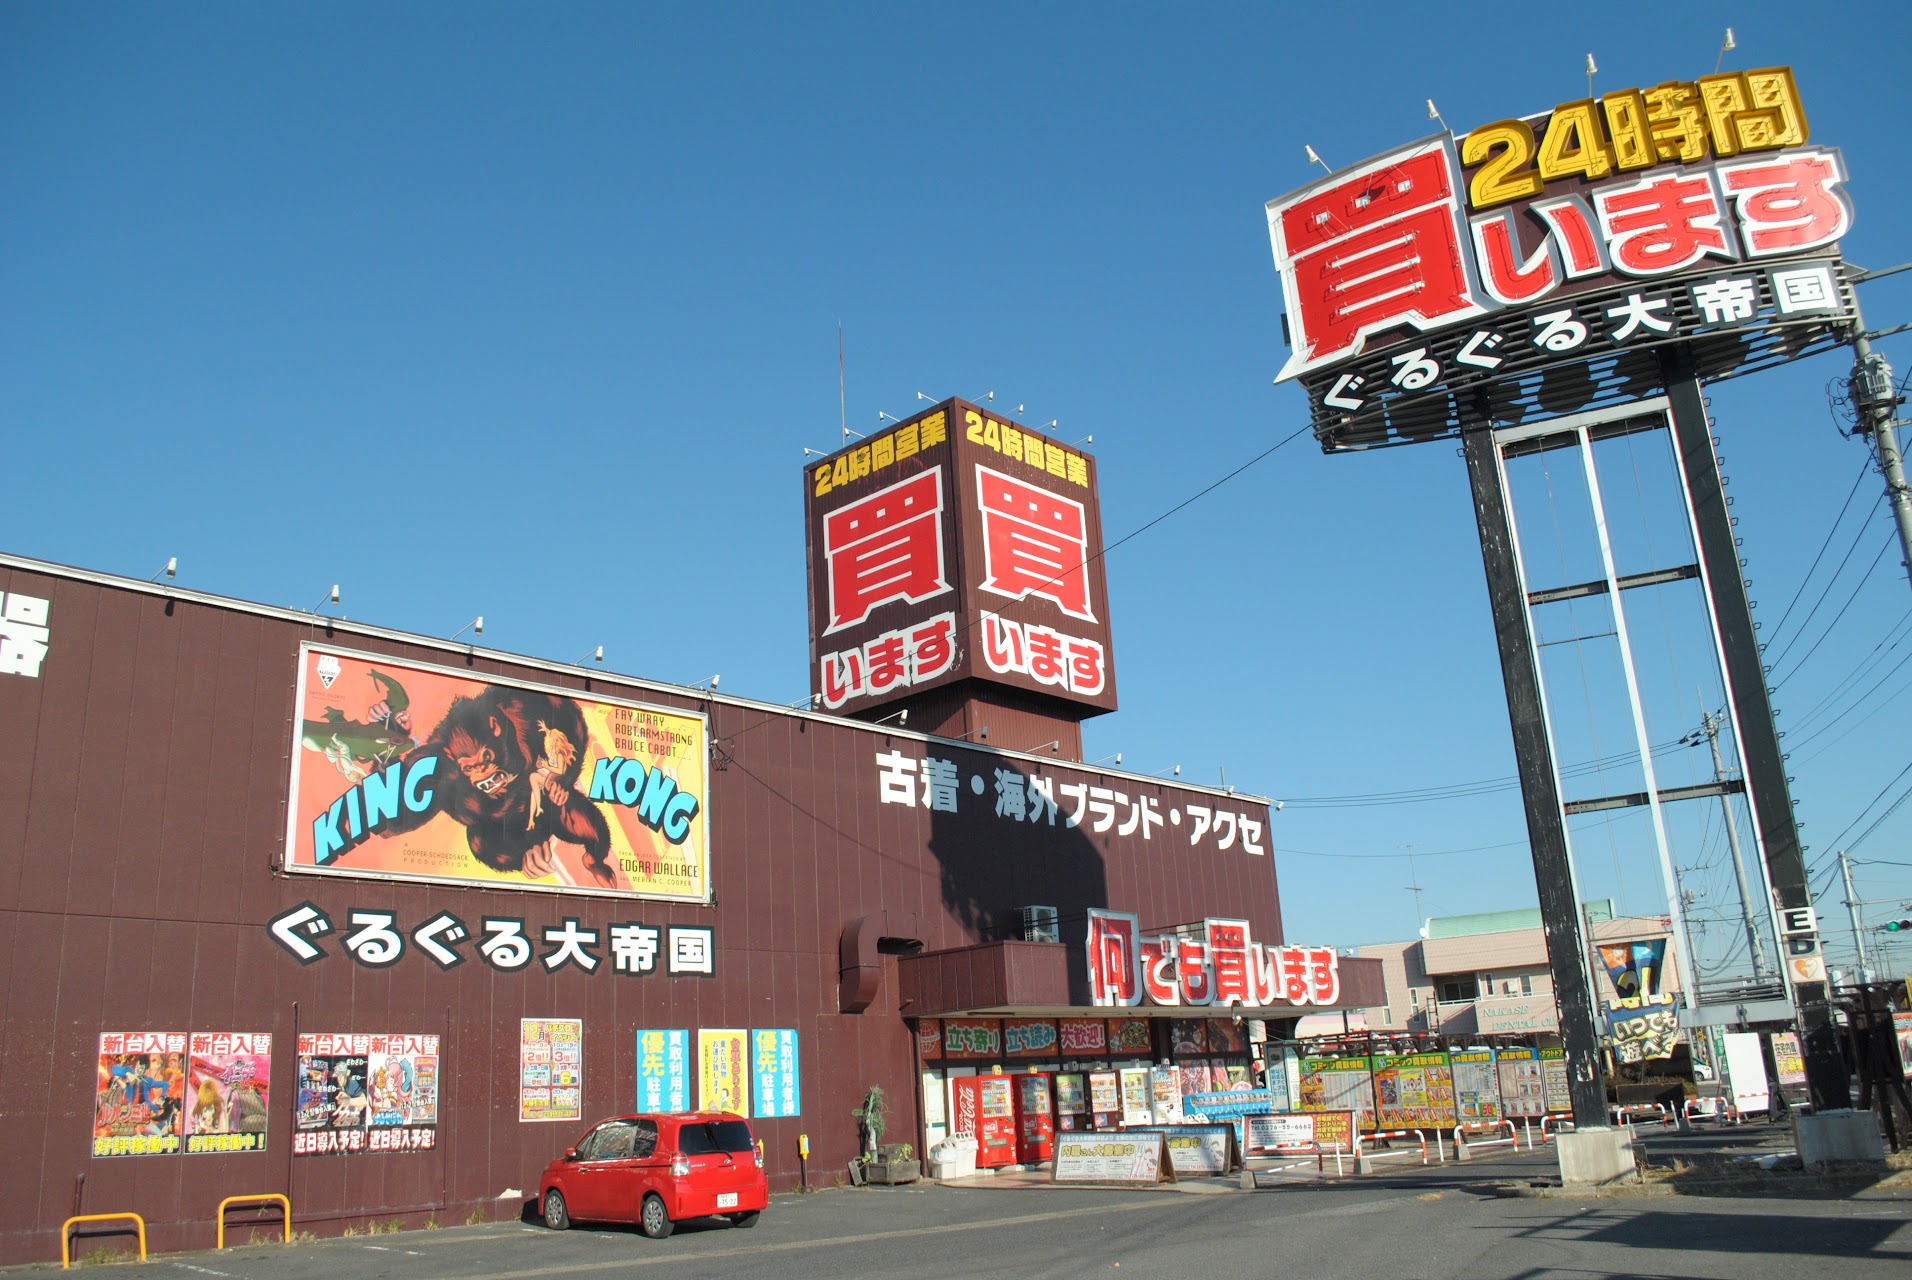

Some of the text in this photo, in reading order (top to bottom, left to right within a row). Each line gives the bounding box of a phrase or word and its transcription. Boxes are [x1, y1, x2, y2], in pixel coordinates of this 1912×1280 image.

[1461, 66, 1810, 209] 24時間
[1265, 129, 1855, 386] 買います
[1322, 263, 1841, 412] ぐるぐる大帝国
[815, 410, 947, 498] 24時間営業
[965, 410, 1088, 488] 24時間営業
[821, 464, 955, 637] 買
[975, 463, 1099, 624] 買
[821, 611, 957, 710] います
[980, 609, 1105, 697] います
[615, 708, 633, 722] FAY
[636, 712, 665, 727] WRAY
[615, 738, 676, 757] BRUCE CABOT
[312, 755, 441, 866] KING
[589, 755, 700, 846] KONG
[876, 750, 1264, 856] 古着・海外ブランド・アクセ
[403, 858, 469, 869] PRODUCTION
[619, 858, 698, 878] EDGAR WALLACE
[632, 876, 657, 884] MERIAN
[268, 900, 715, 977] ぐるぐる大帝国
[1087, 907, 1340, 1008] 何でも買います
[1483, 1005, 1529, 1017] NAKASE
[1492, 1019, 1538, 1031] DENTAL
[1613, 1010, 1677, 1039] いつでも
[103, 1034, 187, 1054] 新台入替
[192, 1034, 271, 1055] 新台入替
[298, 1035, 370, 1055] 新台入替
[371, 1036, 438, 1056] 新台入替
[551, 1033, 576, 1042] イベント
[946, 1023, 1000, 1053] 立ち寄り
[1005, 1023, 1057, 1053] 立ち読み
[1060, 1023, 1106, 1049] 大歓迎!
[1621, 1031, 1675, 1064] 遊べる
[712, 1040, 720, 1096] お運び致します
[730, 1037, 742, 1111] 台車あります
[780, 1030, 795, 1116] 買取利用者様
[1311, 1060, 1364, 1071] コミック買取情報
[1386, 1055, 1443, 1067] コミック買取情報
[97, 1103, 152, 1127] ルパン三世
[94, 1135, 180, 1155] 好評稼働中
[294, 1130, 365, 1154] 近日導入予定!
[369, 1128, 436, 1150] 近日導入予定!
[1061, 1143, 1135, 1157] 内職さん大募集中
